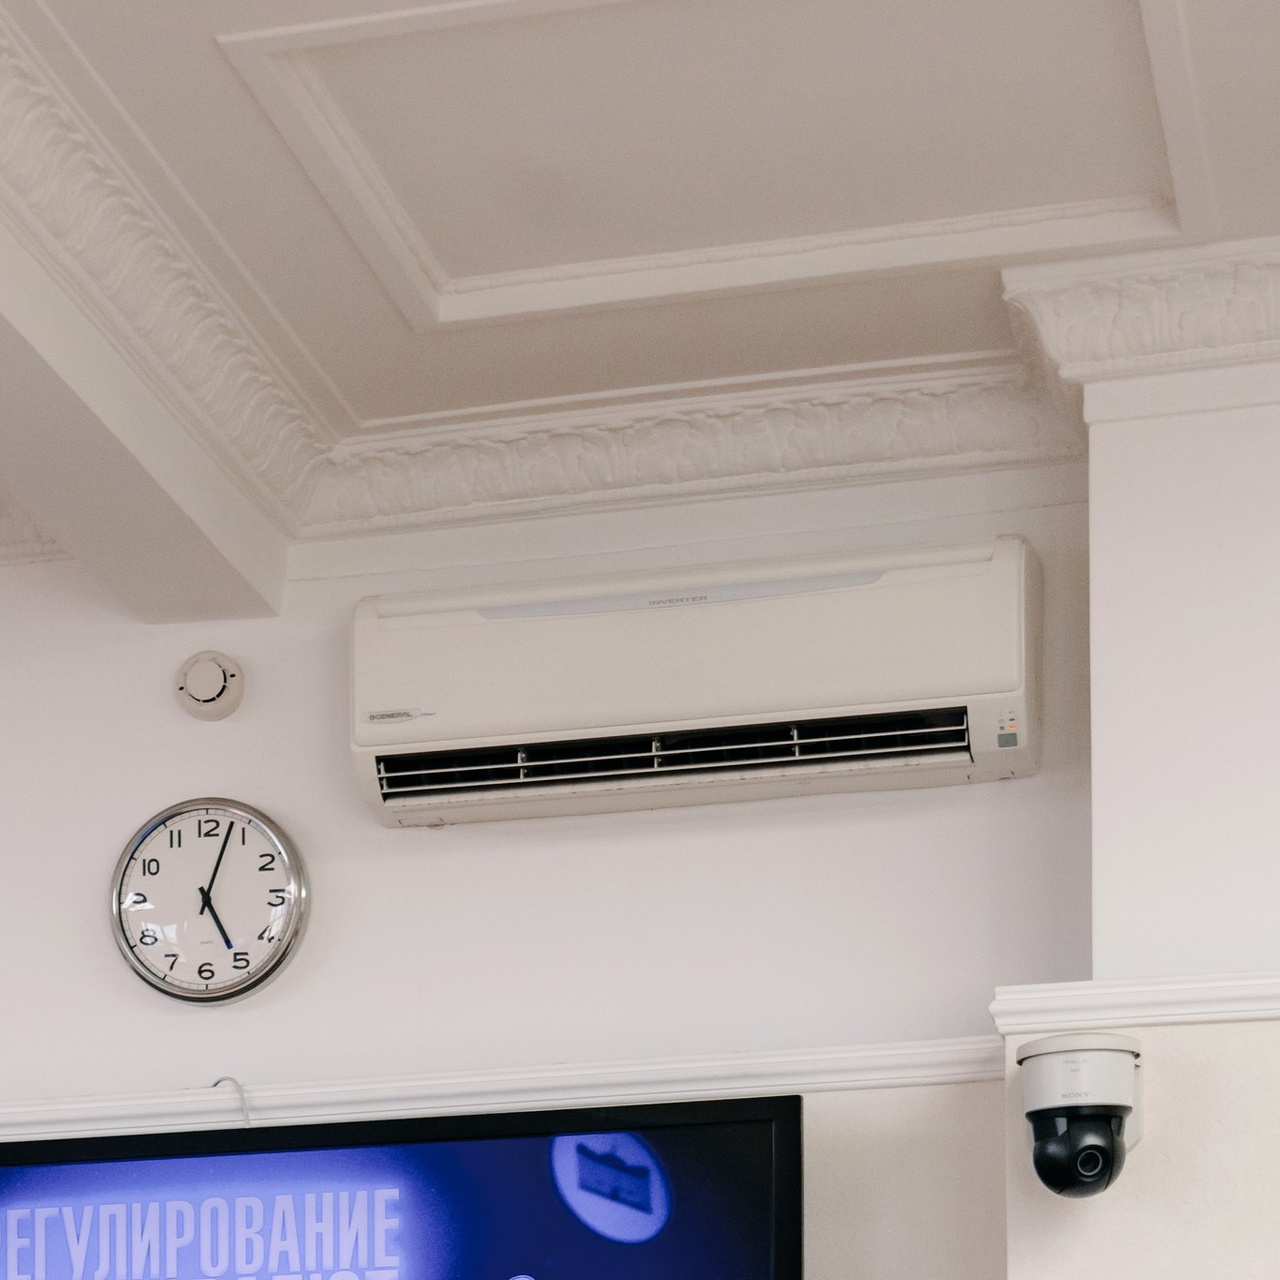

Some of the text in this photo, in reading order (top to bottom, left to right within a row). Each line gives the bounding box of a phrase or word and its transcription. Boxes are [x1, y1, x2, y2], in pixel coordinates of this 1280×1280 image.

[197, 819, 220, 838] 12
[241, 826, 246, 846] 1
[169, 829, 182, 848] 11
[142, 858, 160, 876] 10
[258, 853, 276, 872] 2
[266, 888, 286, 907] 3
[139, 928, 159, 946] 8
[164, 953, 180, 971] 7
[232, 951, 251, 970] 5
[197, 962, 215, 980] 6
[1061, 1091, 1090, 1099] SONY
